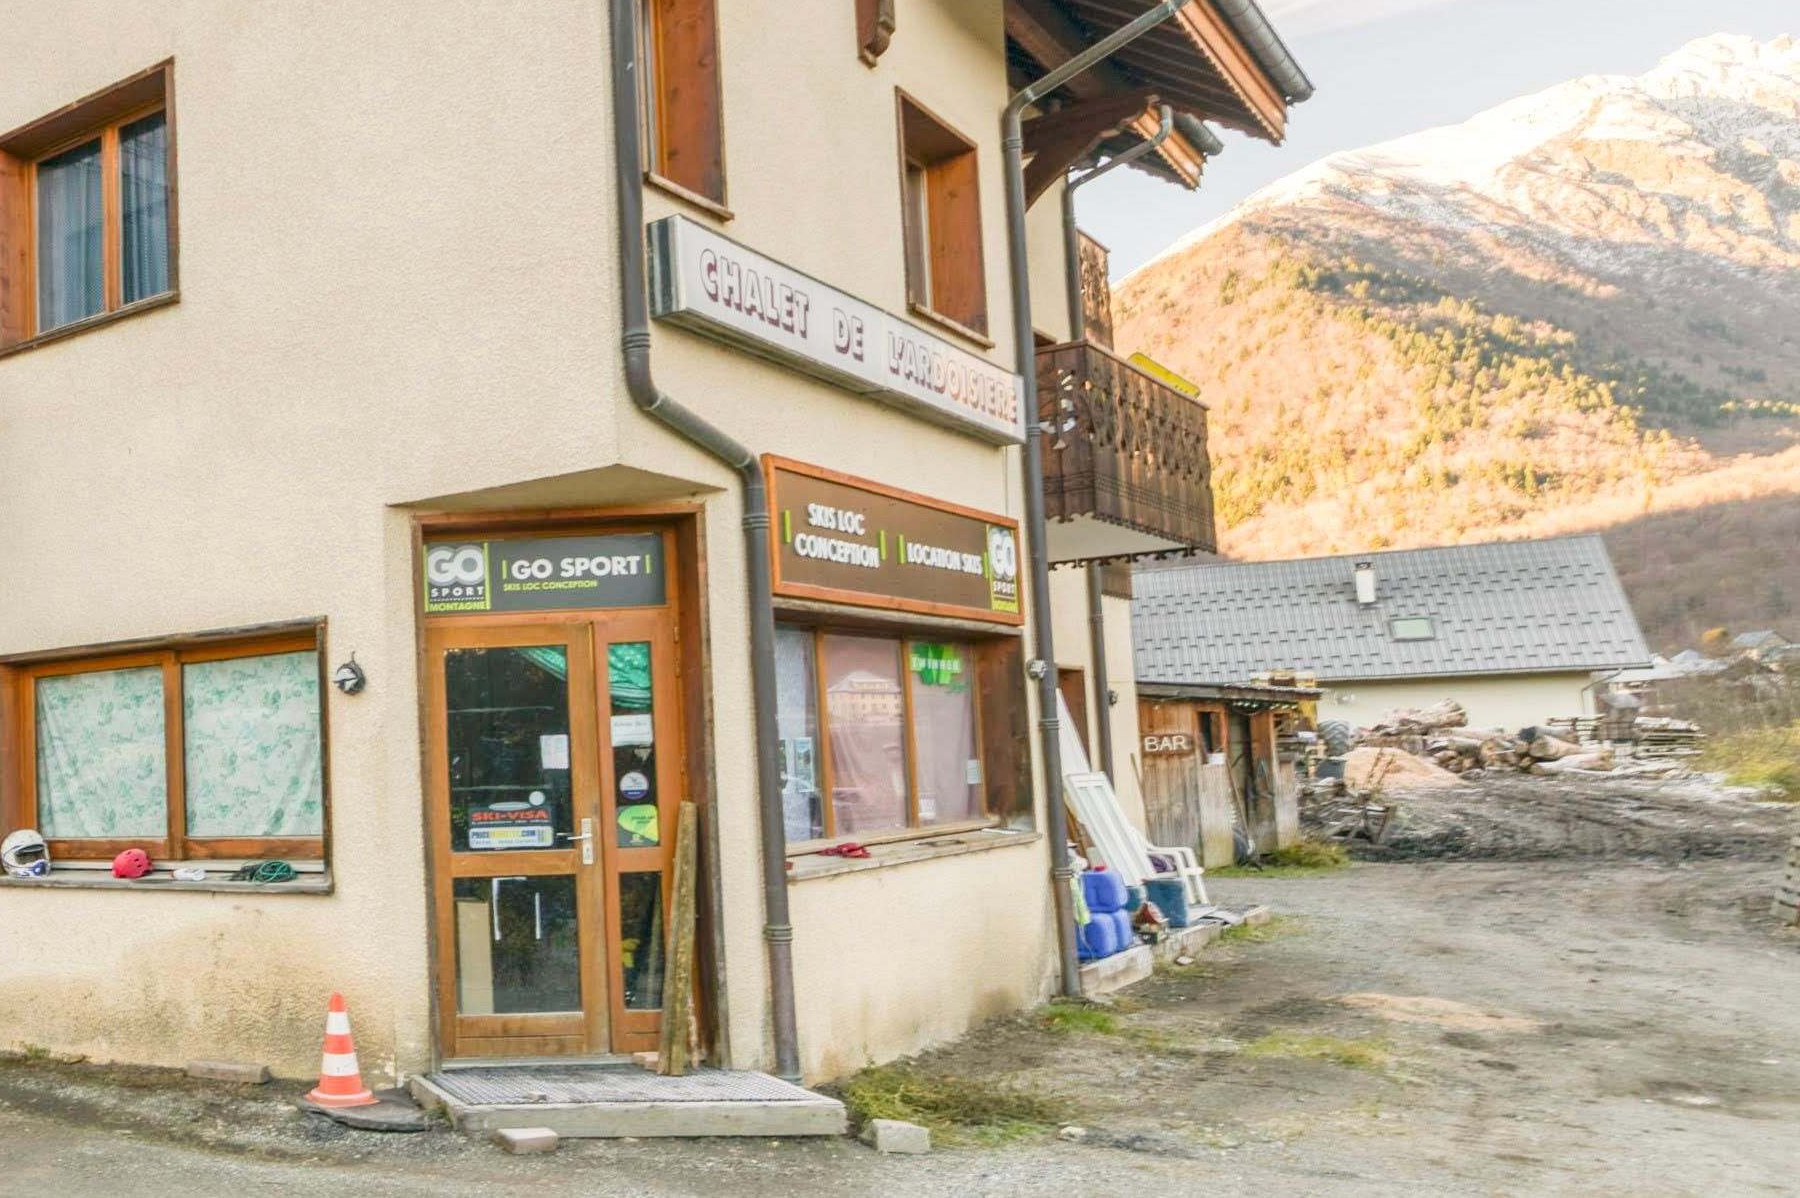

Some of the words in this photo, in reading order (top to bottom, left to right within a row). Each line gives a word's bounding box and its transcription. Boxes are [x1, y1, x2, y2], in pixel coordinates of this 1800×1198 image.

[700, 248, 809, 339] CHALET
[833, 307, 864, 362] DE
[888, 331, 1017, 424] L'ARDOISIERE
[807, 503, 836, 530] SKIS
[837, 510, 866, 536] LOC
[427, 548, 485, 582] GO
[794, 532, 880, 569] CONCEPTION
[907, 542, 961, 571] LOCATION
[962, 553, 983, 576] SKIS
[990, 530, 1016, 578] GO
[511, 558, 553, 580] GO
[560, 556, 641, 578] SPORT
[431, 586, 484, 598] SPORT
[522, 582, 541, 591] LOC
[542, 580, 598, 590] CONCEPTION
[429, 601, 486, 612] MONTAGNE
[1144, 735, 1188, 752] BAR
